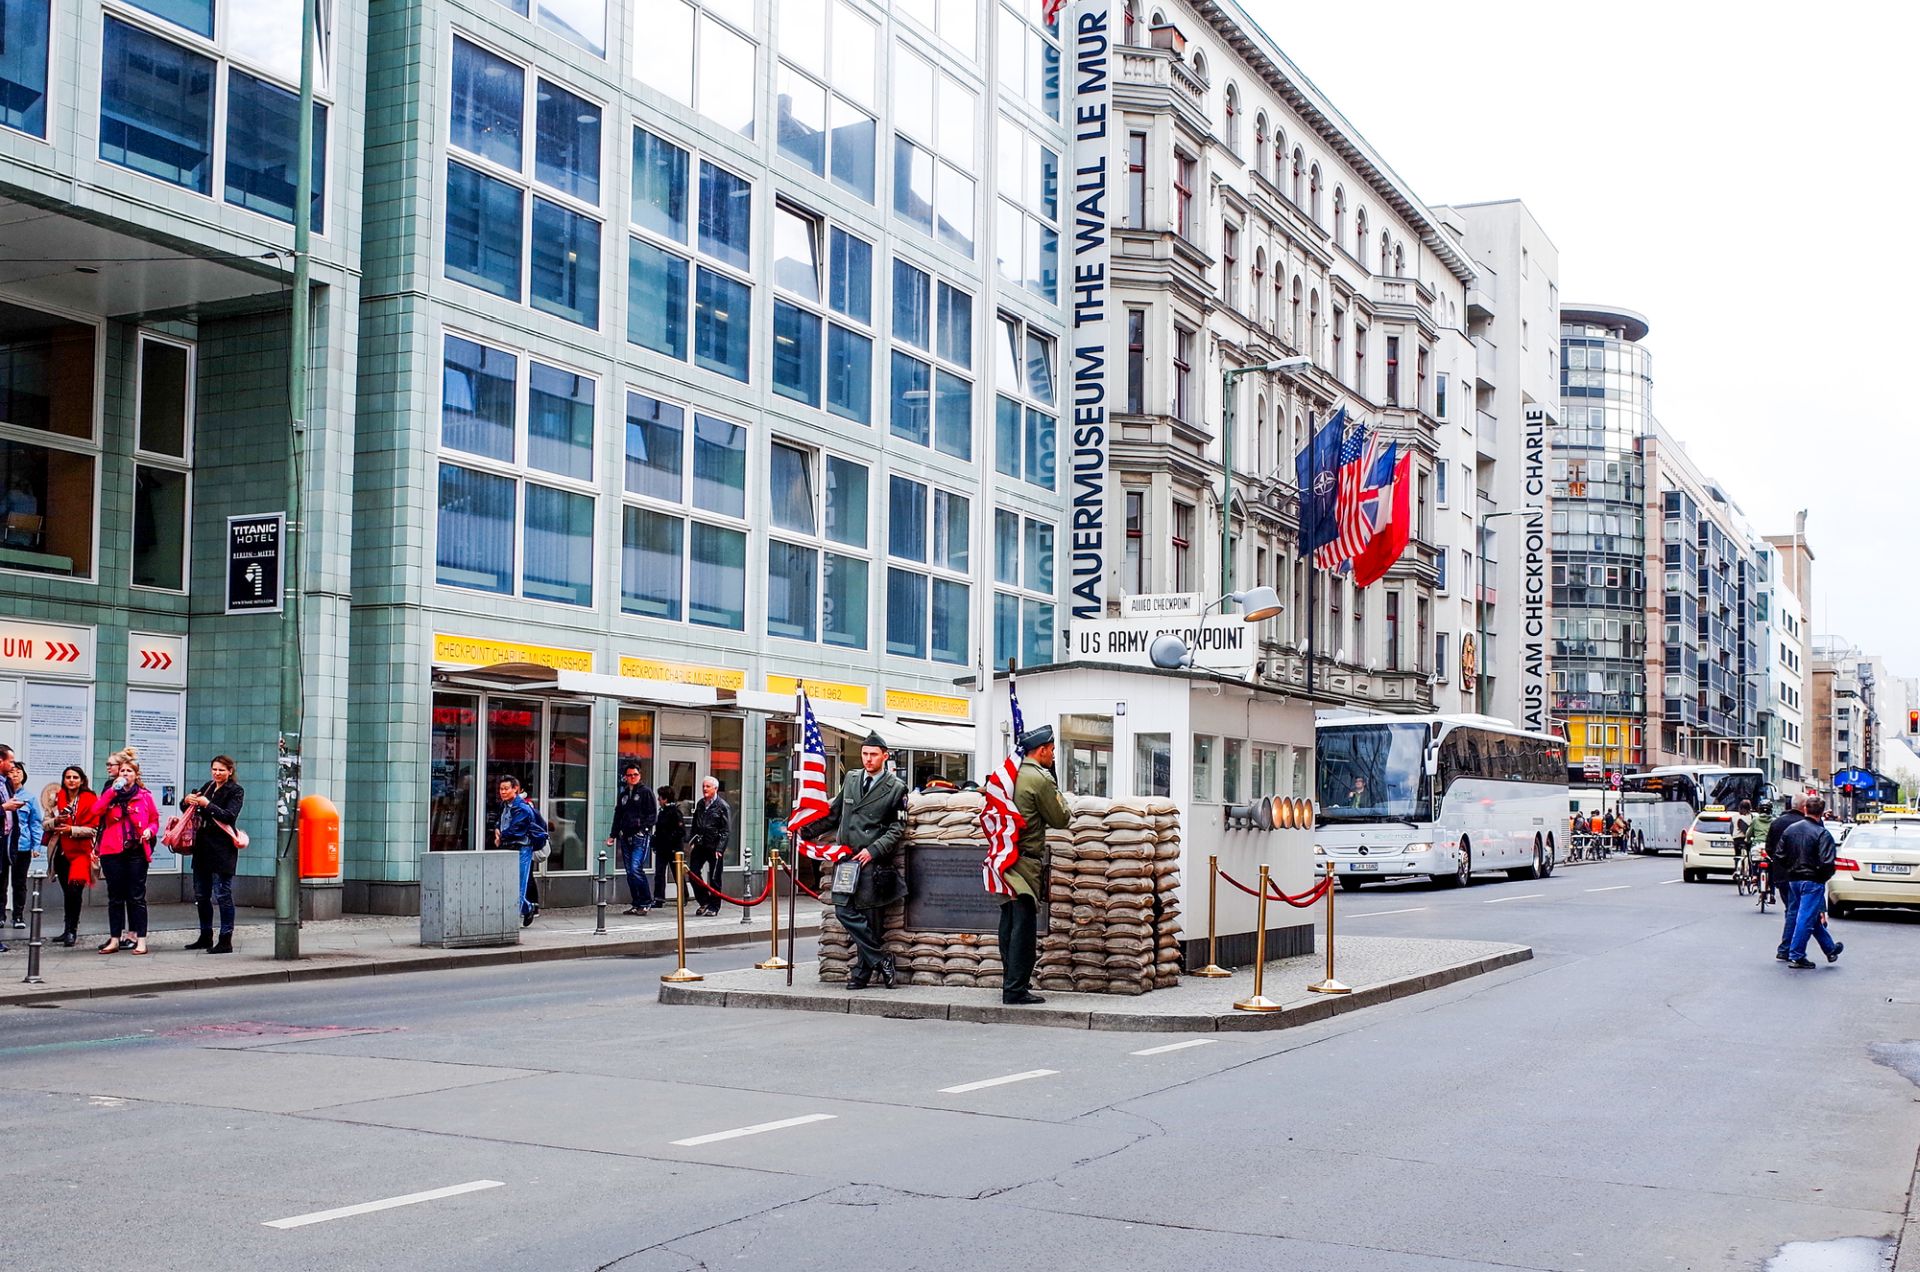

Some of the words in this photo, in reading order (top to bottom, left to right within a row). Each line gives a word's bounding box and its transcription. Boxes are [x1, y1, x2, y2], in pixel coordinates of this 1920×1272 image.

[1077, 10, 1107, 95] MUR
[1076, 103, 1107, 141] LE
[1075, 156, 1106, 256] WALL
[1074, 263, 1104, 329] THE
[1526, 410, 1543, 495] CHARLIE
[232, 523, 277, 536] TITANIC
[237, 534, 275, 544] HOTEL
[1131, 598, 1152, 612] ALLIED
[1153, 597, 1192, 611] CHECKPOINT
[3, 637, 33, 660] UM
[1080, 631, 1101, 654] US
[1108, 630, 1149, 653] ARMY
[1155, 626, 1246, 651] CKPOINT
[437, 641, 490, 661] CHECKPOINT
[492, 648, 526, 663] CHARLIE
[529, 653, 589, 673] MUSEUMSSHOP
[1525, 643, 1543, 677] AM
[621, 663, 663, 680] CHECKPOINT
[664, 668, 692, 684] CHARLIE
[693, 672, 742, 689] MUSEUMSSHOP
[795, 683, 820, 698] NCE
[822, 687, 842, 700] 1962
[886, 695, 914, 709] CHECKPOINT
[914, 698, 932, 711] CHARLIE
[1849, 771, 1859, 781] U
